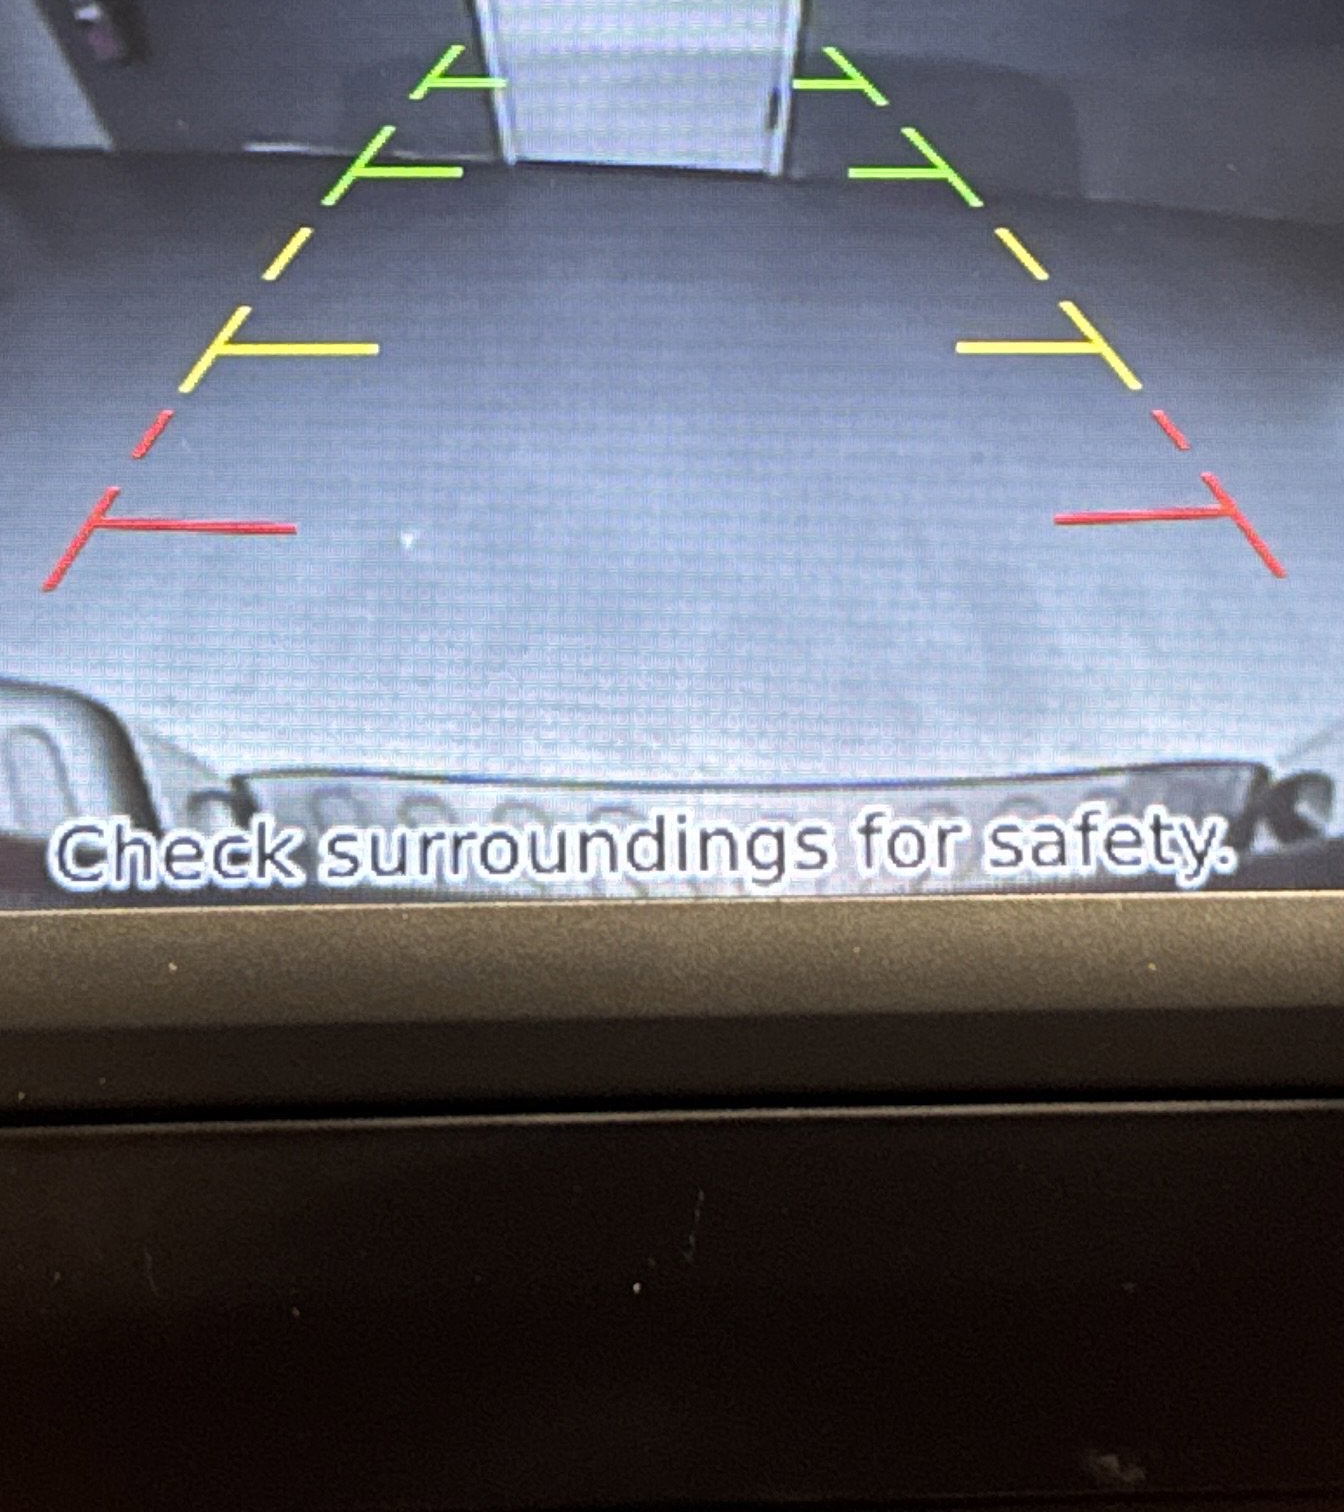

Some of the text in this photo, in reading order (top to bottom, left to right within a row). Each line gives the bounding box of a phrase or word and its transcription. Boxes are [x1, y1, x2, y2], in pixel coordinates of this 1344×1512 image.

[48, 804, 1238, 890] Check surroundings for safety.
